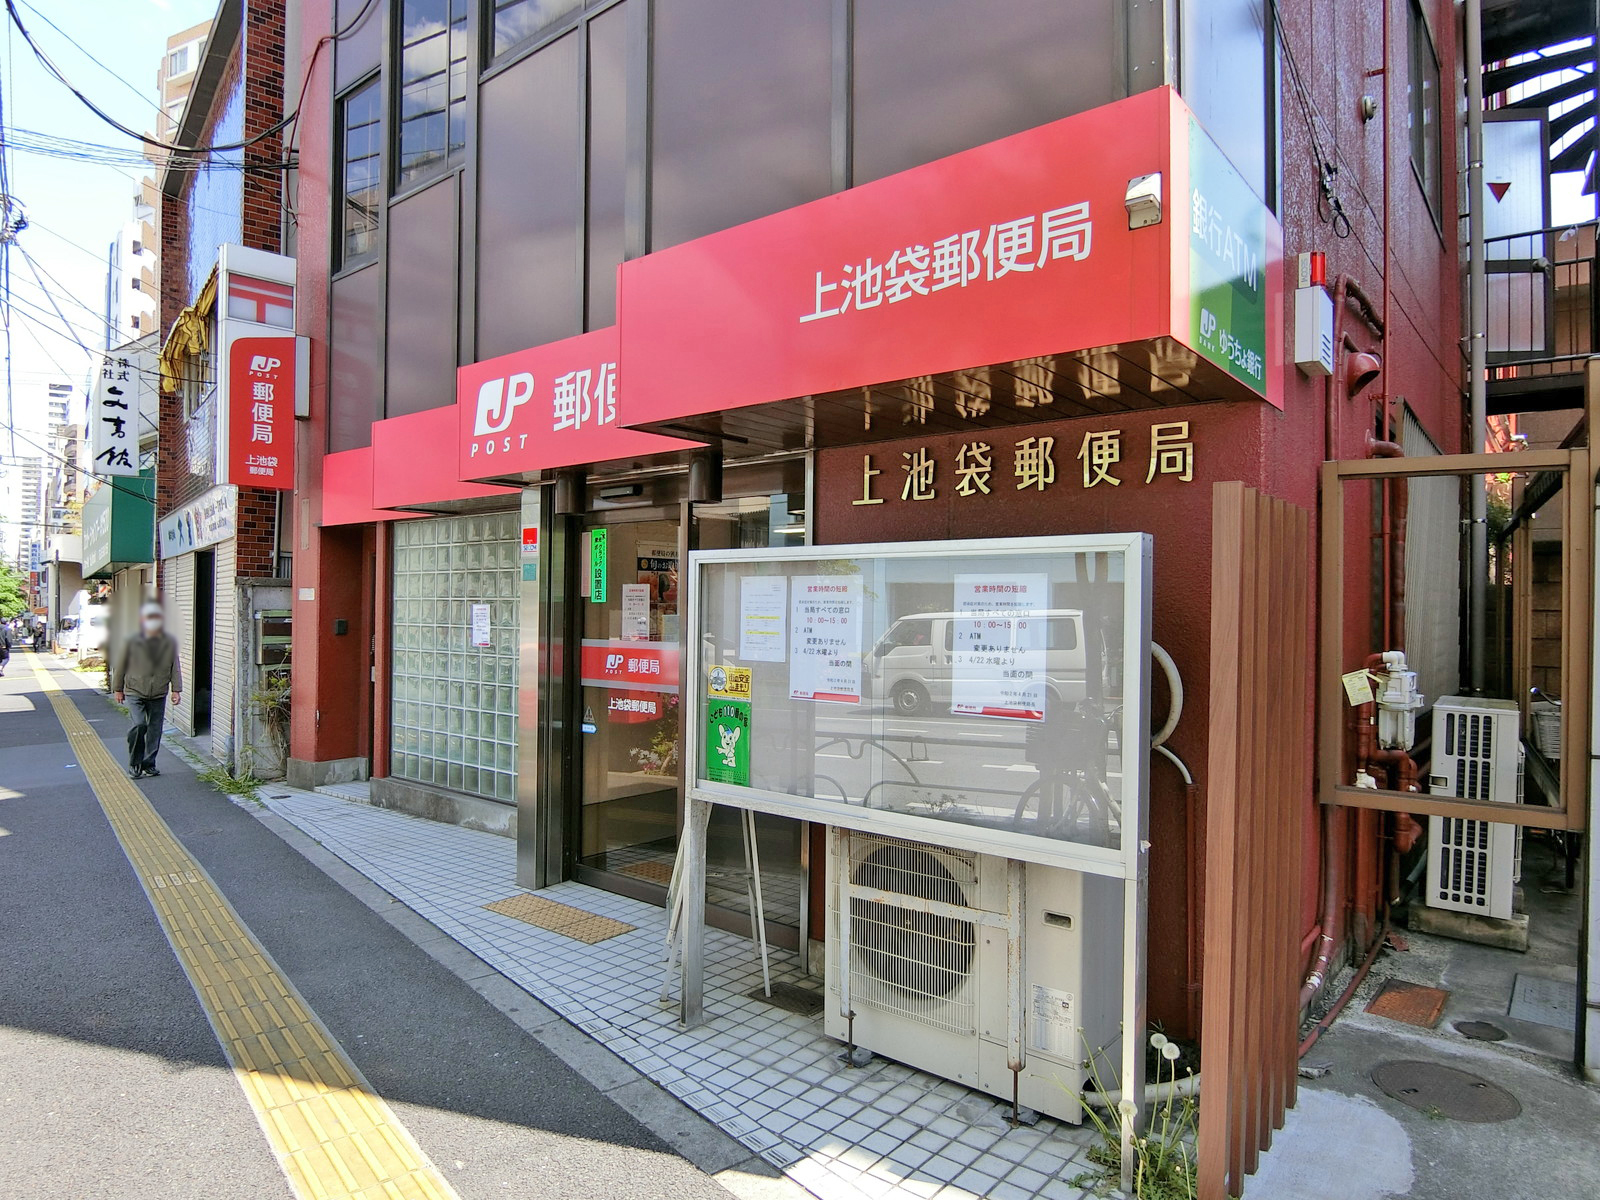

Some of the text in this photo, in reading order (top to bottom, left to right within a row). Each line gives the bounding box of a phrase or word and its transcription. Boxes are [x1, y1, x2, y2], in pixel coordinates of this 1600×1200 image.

[1192, 188, 1257, 292] 銀行ATM
[800, 201, 1092, 323] 上池袋郵便局
[1199, 337, 1215, 352] BANK
[1219, 328, 1261, 381] ゆうちょ銀行
[248, 371, 279, 380] POST
[252, 382, 275, 444] 郵便局
[470, 434, 528, 458] POST
[245, 454, 278, 468] 上池袋
[852, 421, 1195, 506] 上池袋郵便局
[249, 466, 275, 477] 郵便局
[974, 585, 1028, 593] 営業時間の短縮
[804, 606, 850, 614] 当局すべての窓口
[806, 638, 847, 646] 変更ありません
[969, 632, 981, 640] ATM
[973, 644, 1026, 654] 変更ありません
[627, 658, 660, 675] 郵便局
[828, 660, 852, 668] 当面の間
[969, 656, 984, 664] 4/22
[986, 657, 1015, 666] 水曜より
[1002, 670, 1033, 679] 当面の間
[608, 697, 657, 714] 上池袋郵便局
